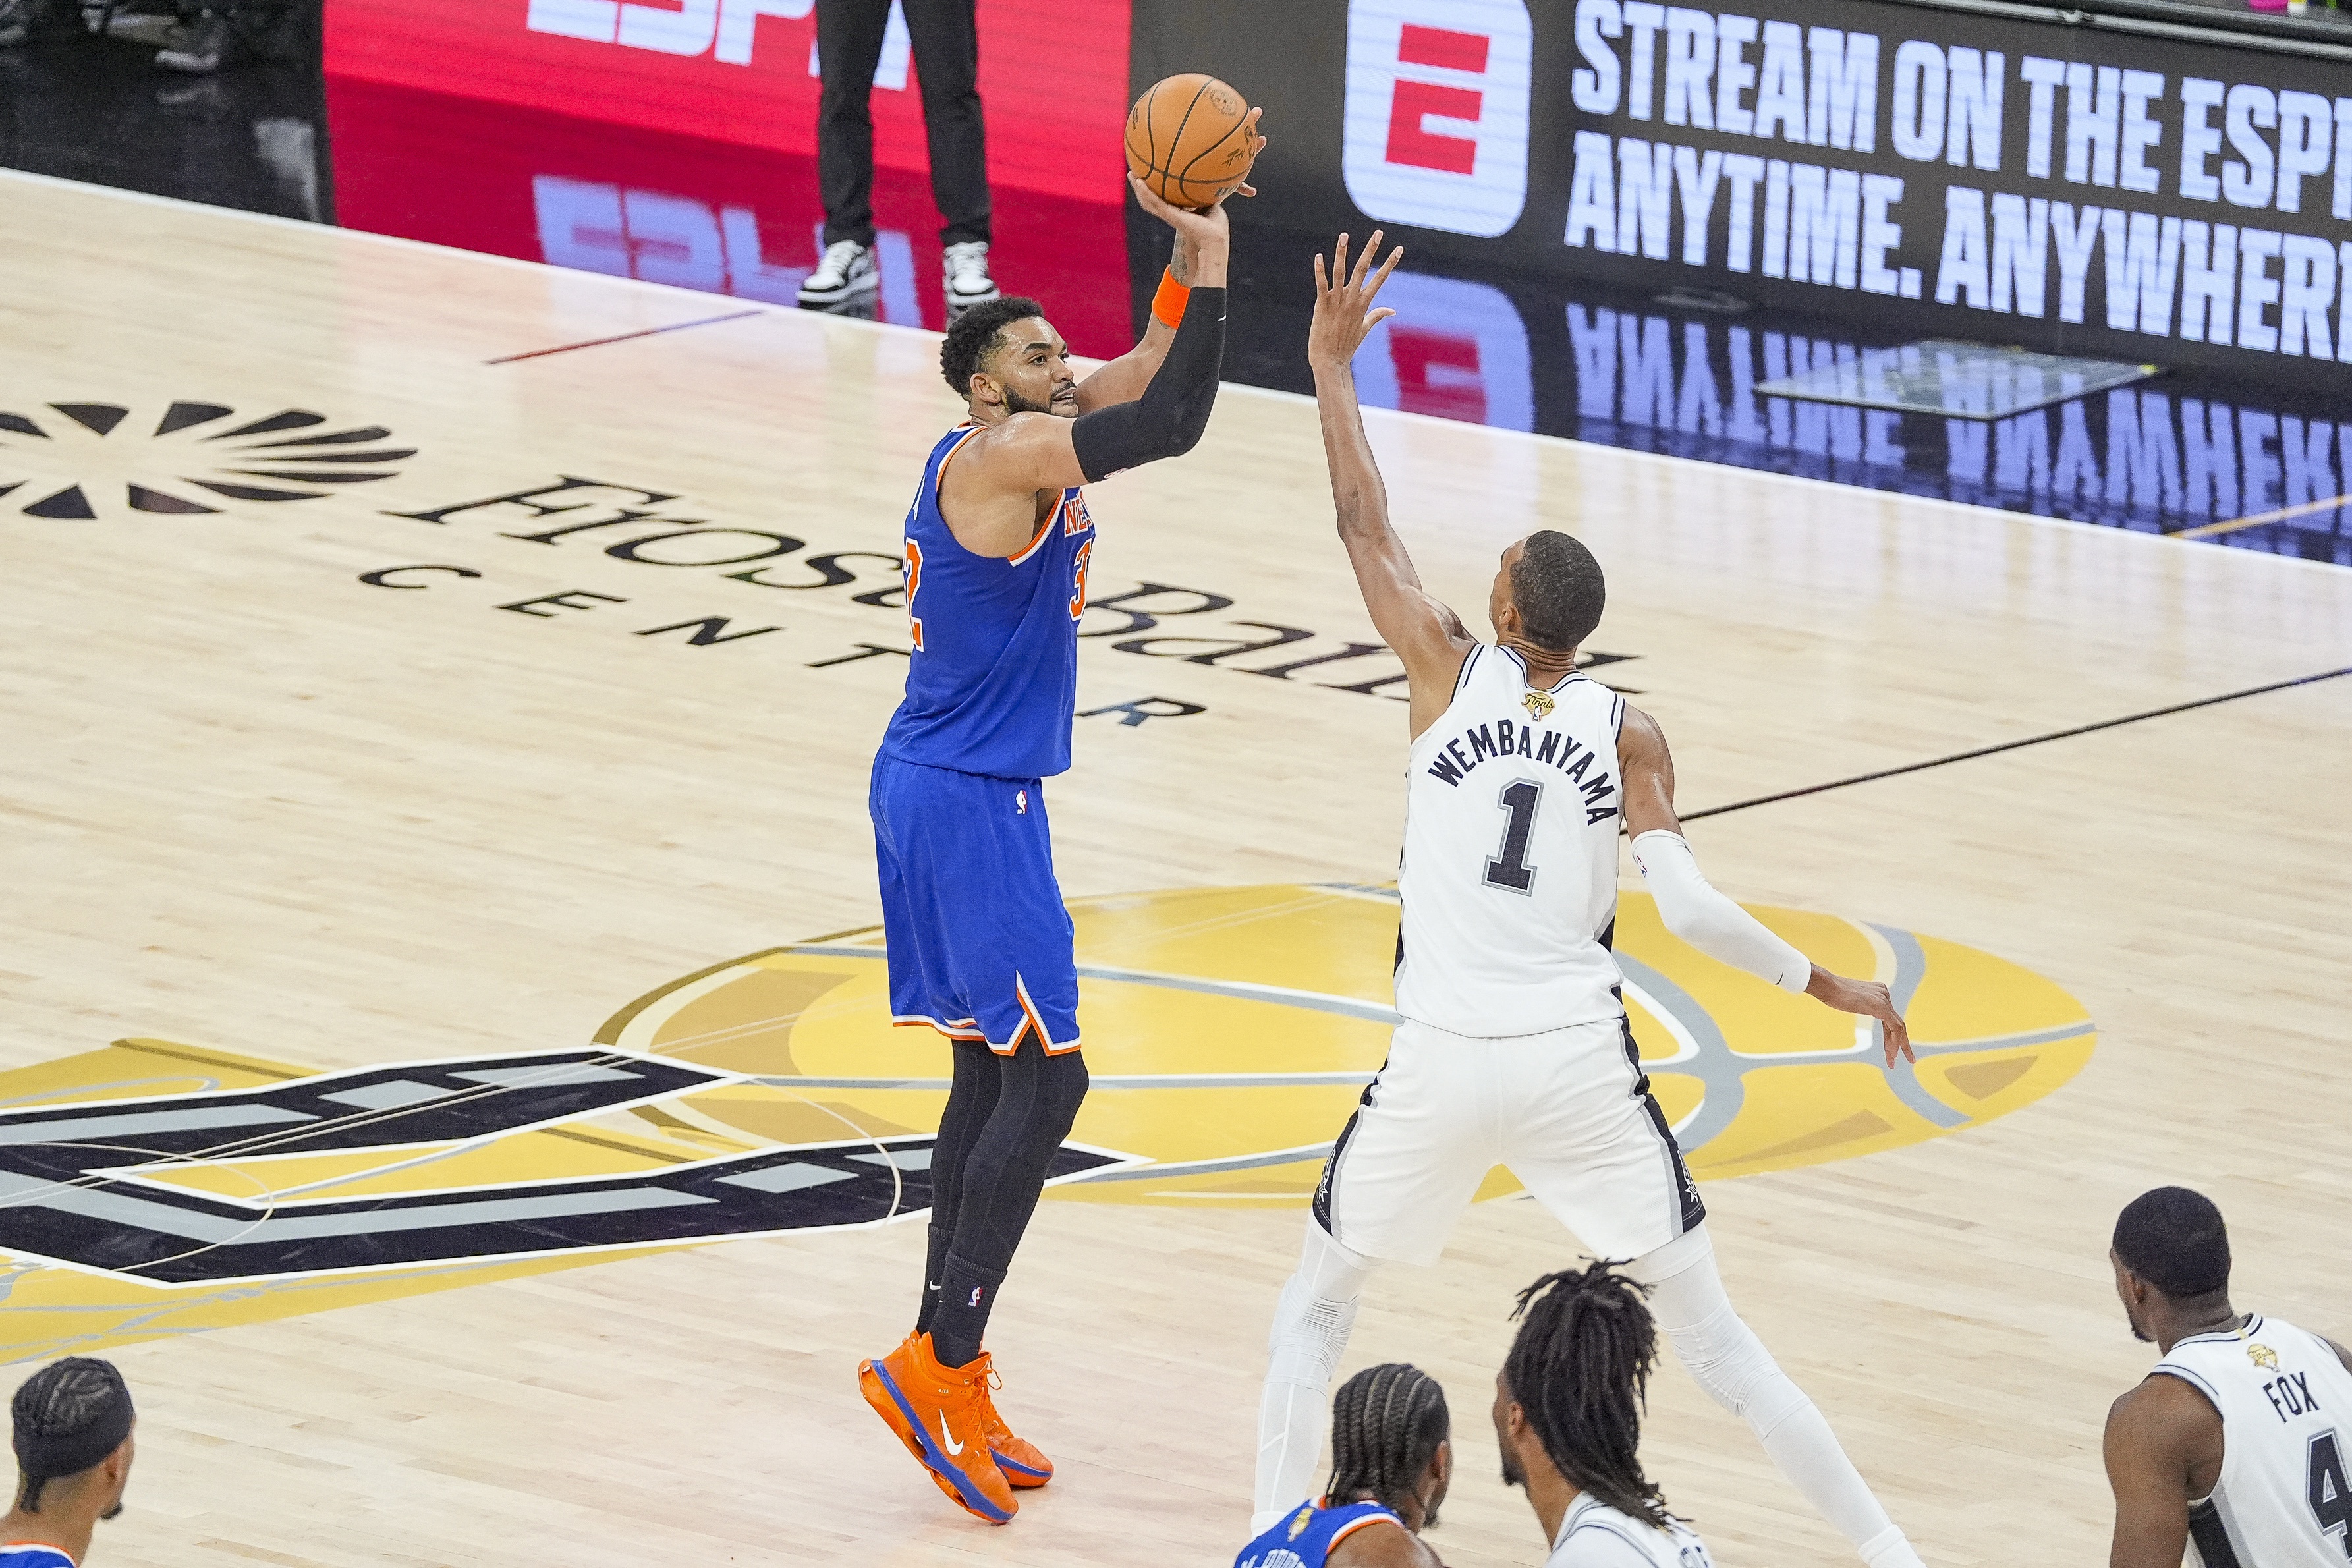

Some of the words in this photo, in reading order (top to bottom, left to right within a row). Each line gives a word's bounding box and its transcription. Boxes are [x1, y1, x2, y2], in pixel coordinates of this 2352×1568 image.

[1572, 0, 1880, 153] STREAM
[1891, 40, 2005, 172] ON
[2020, 55, 2165, 194] THE
[1563, 130, 1922, 300] ANYTIME.
[359, 565, 1209, 727] CENTR
[1523, 694, 1554, 708] Finals
[1428, 719, 1618, 826] WEMBANYAMA
[1482, 777, 1544, 897] 1
[2262, 1371, 2320, 1423] FOX
[2306, 1427, 2352, 1563] 4
